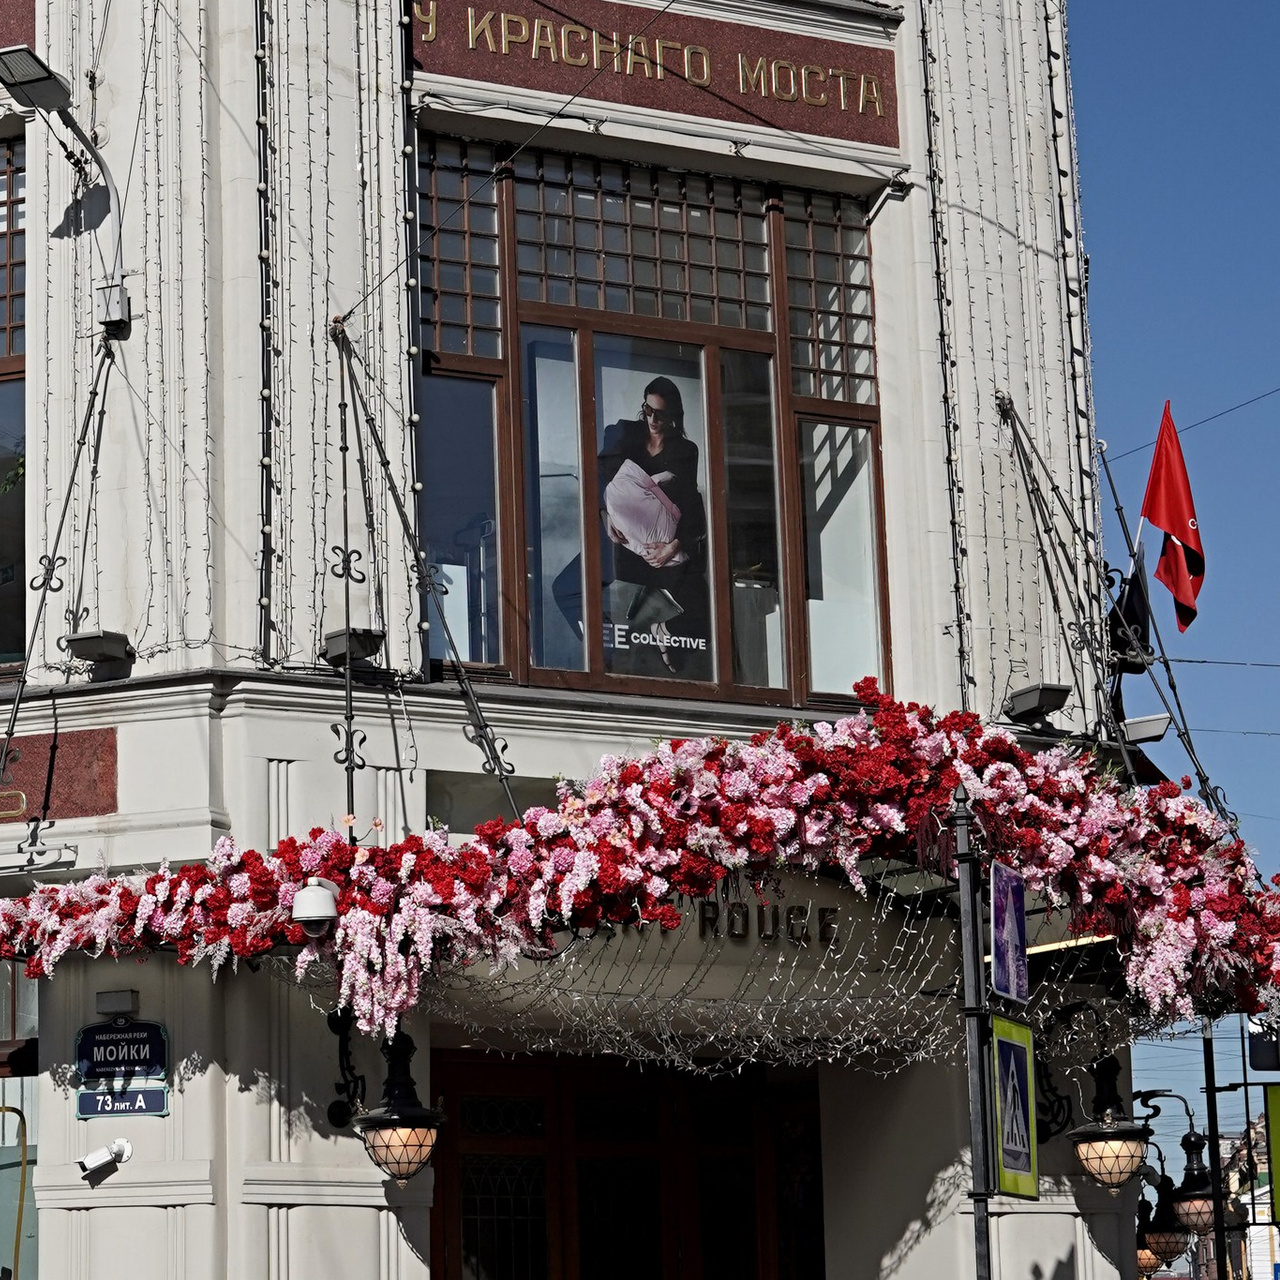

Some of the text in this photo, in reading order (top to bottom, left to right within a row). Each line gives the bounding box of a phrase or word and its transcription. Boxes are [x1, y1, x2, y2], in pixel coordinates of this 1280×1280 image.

[467, 7, 712, 88] КРАСНАГО
[738, 53, 885, 117] МОСТА
[630, 632, 707, 650] COLLECTIVE
[93, 1041, 150, 1062] МОЙКИ
[96, 1095, 113, 1111] 73
[114, 1102, 133, 1111] лит.
